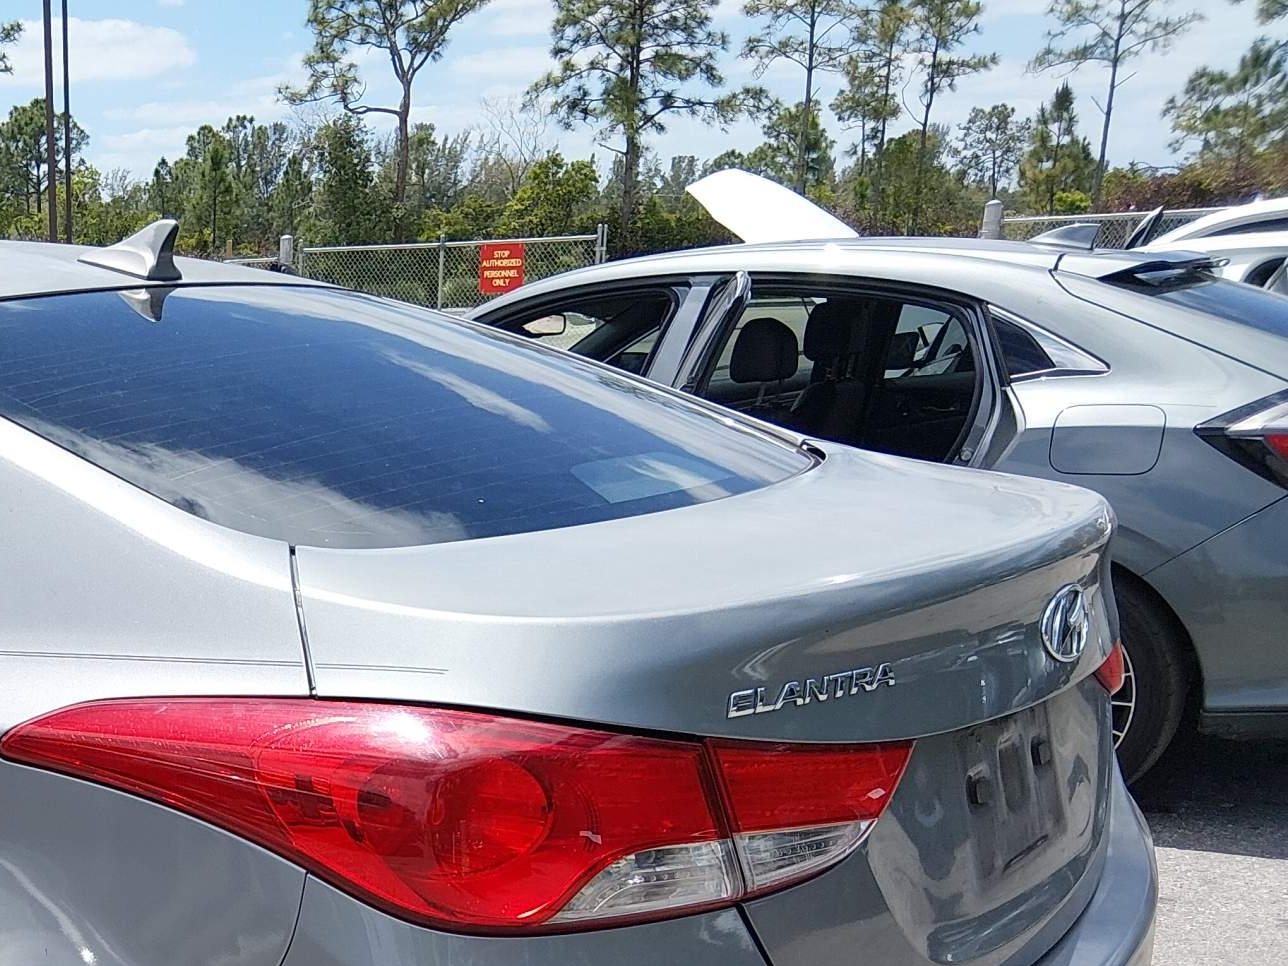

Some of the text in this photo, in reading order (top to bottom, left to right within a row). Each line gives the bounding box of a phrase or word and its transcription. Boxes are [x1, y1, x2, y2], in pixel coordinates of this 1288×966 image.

[494, 250, 510, 258] STOP
[482, 259, 522, 267] AUTHORIZED
[483, 270, 519, 278] PERSONNEL
[492, 279, 510, 287] ONLY
[727, 662, 896, 719] ELANTRA
